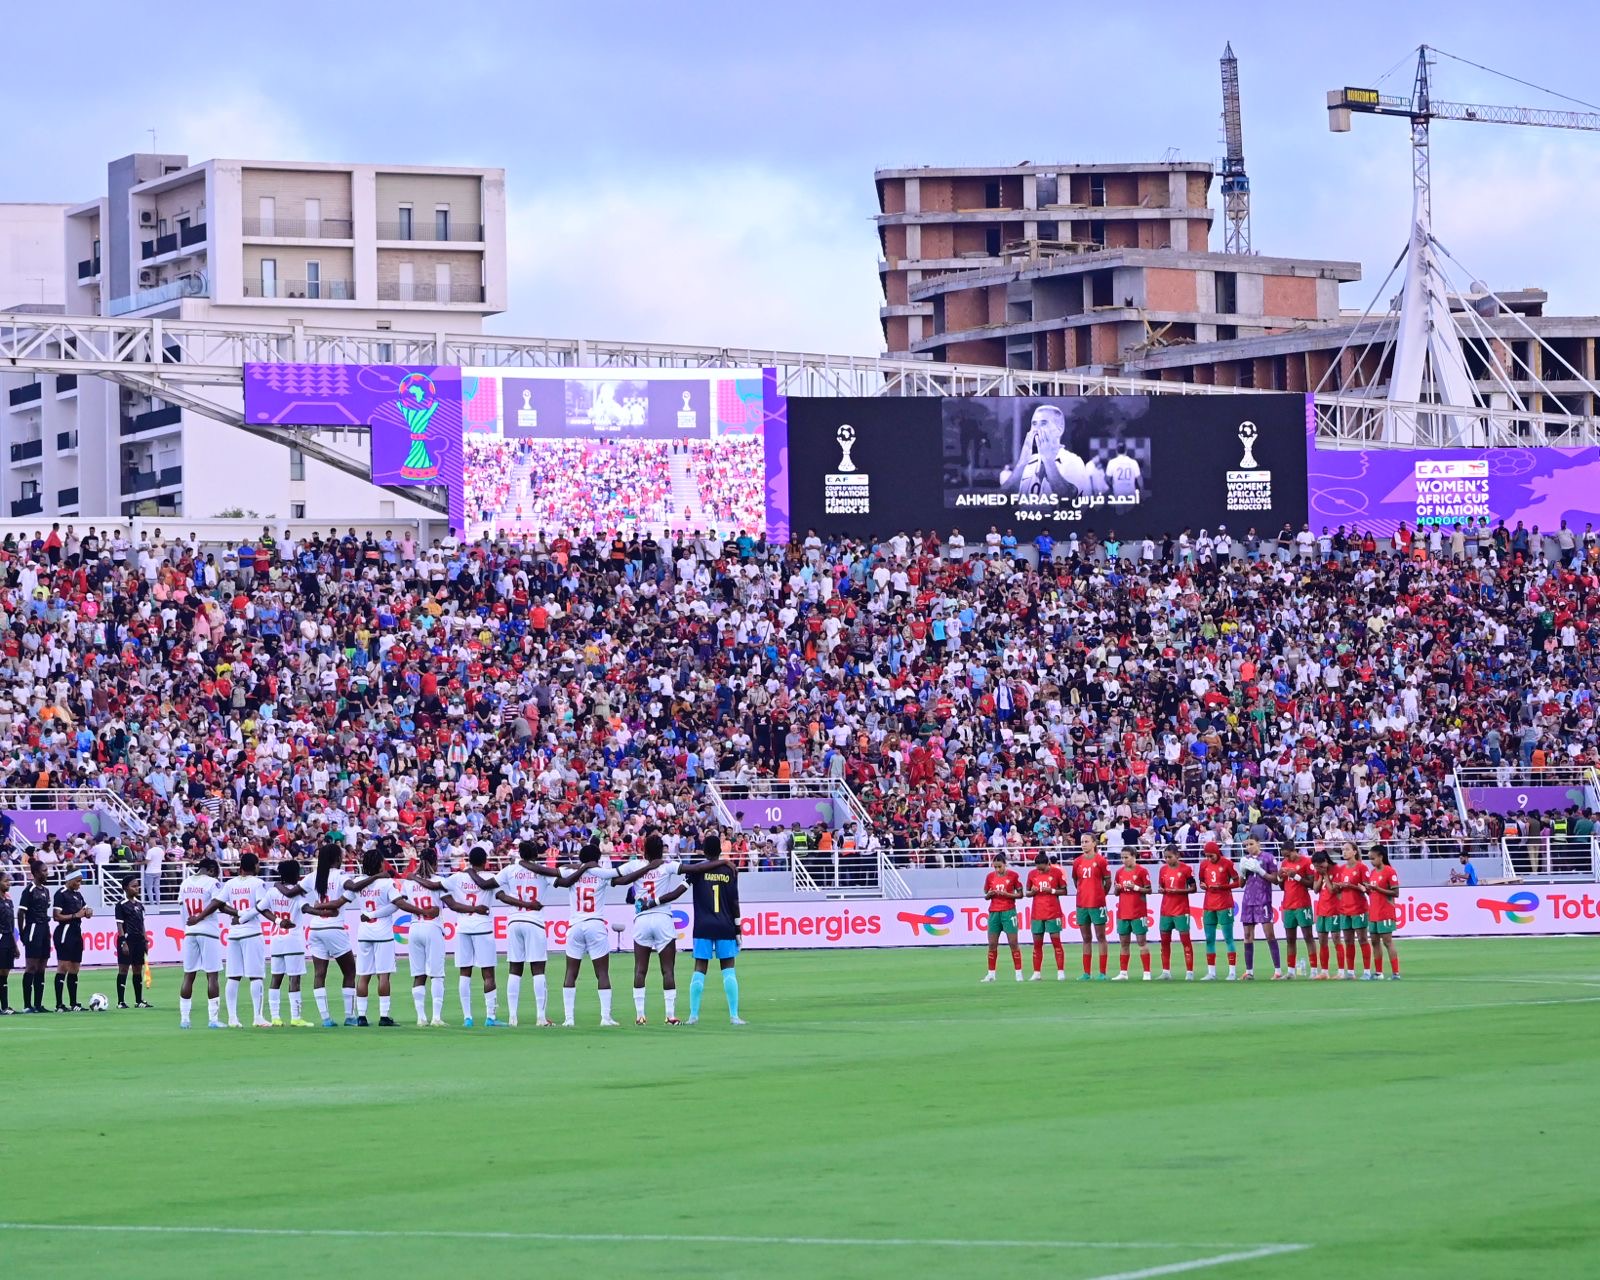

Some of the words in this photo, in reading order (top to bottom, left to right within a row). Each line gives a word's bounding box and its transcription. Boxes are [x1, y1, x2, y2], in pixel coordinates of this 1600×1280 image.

[1116, 467, 1132, 481] 20
[1418, 464, 1455, 474] CAF
[1226, 482, 1272, 491] WOMEN'S
[1416, 480, 1489, 493] WOMEN'S
[825, 490, 839, 498] DES
[839, 490, 869, 498] NATIONS
[955, 493, 1008, 507] AHMED
[1010, 493, 1060, 506] FARAS
[1107, 489, 1141, 506] أحمد
[1227, 490, 1255, 498] AFRICA
[1255, 490, 1272, 498] CUP
[1416, 493, 1462, 505] AFRICA
[1463, 493, 1490, 504] CUP
[825, 497, 870, 507] FÉMININE
[1071, 492, 1105, 510] فرس
[1226, 503, 1262, 511] MOROCCO
[825, 505, 858, 514] MAROC
[858, 505, 870, 514] 24
[1014, 510, 1043, 521] 1946
[1053, 510, 1083, 521] 2025
[1416, 504, 1433, 516] OF
[1435, 504, 1490, 516] NATIONS
[1516, 793, 1529, 809] 9
[764, 806, 783, 822] 10
[34, 817, 48, 834] 11
[1082, 867, 1092, 879] 21
[1210, 871, 1217, 883] 3
[1169, 876, 1175, 888] 7
[516, 884, 538, 912] 13
[576, 886, 595, 913] 15
[711, 884, 720, 914] 1
[1263, 905, 1269, 919] 1
